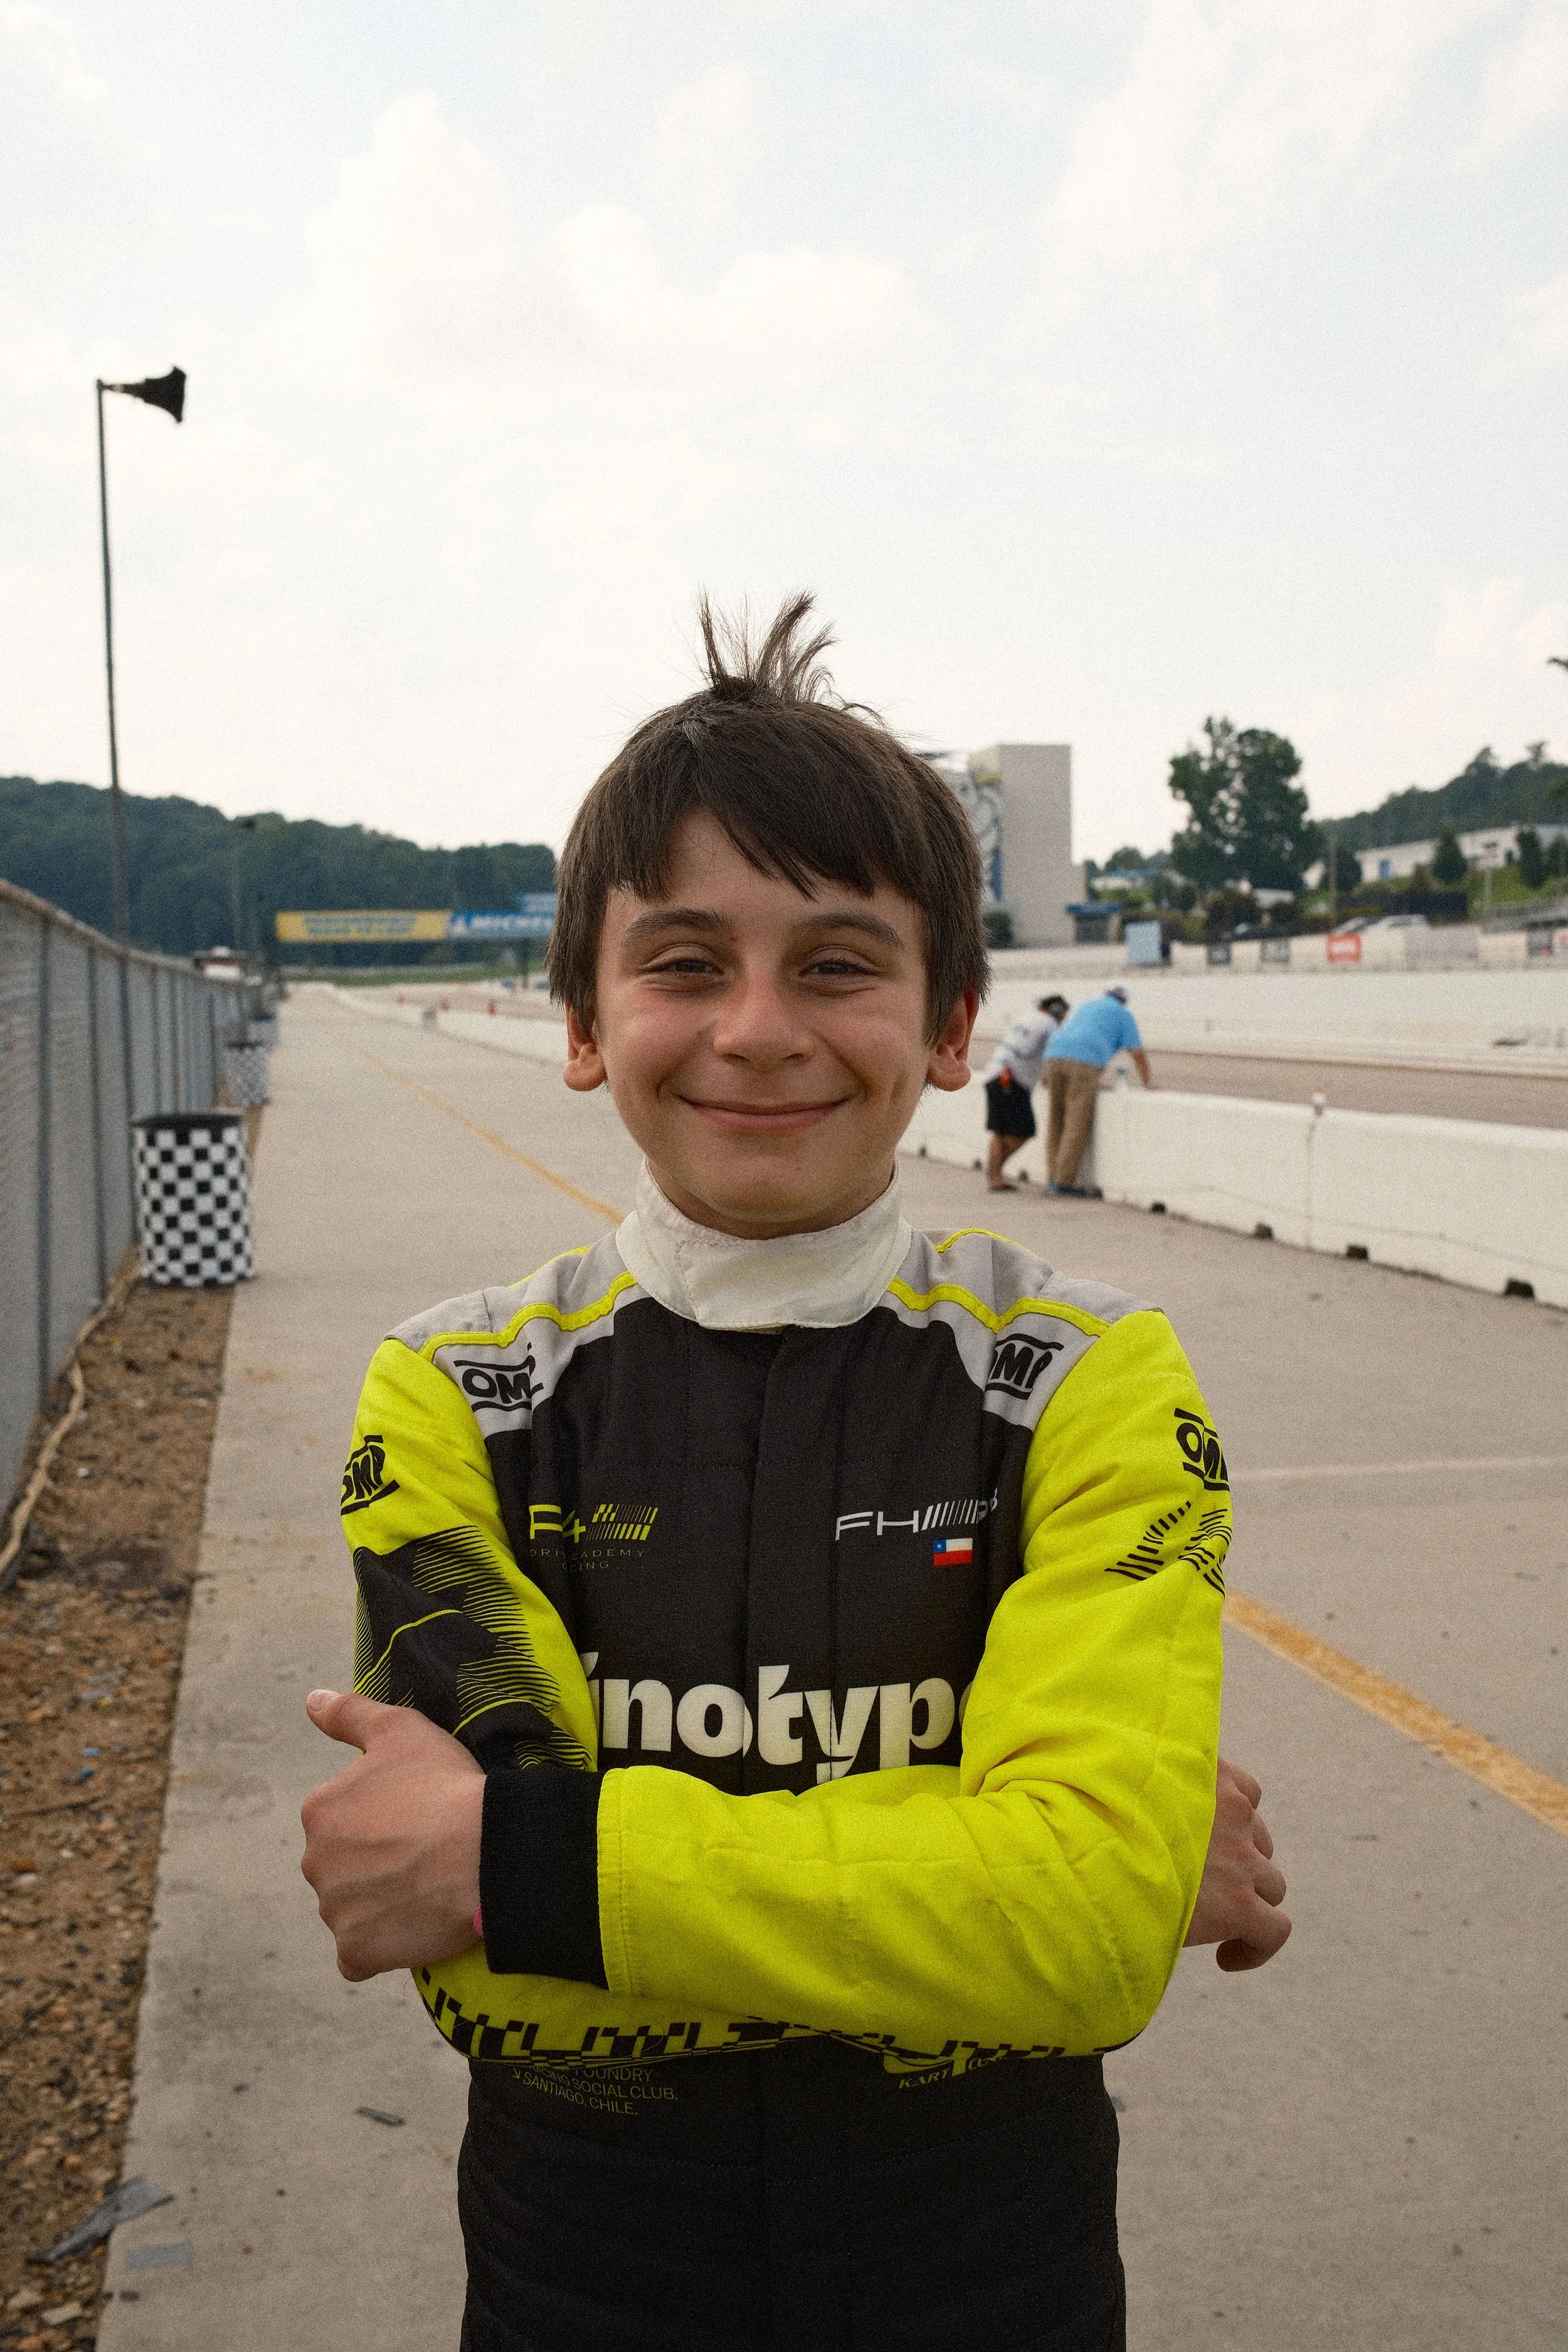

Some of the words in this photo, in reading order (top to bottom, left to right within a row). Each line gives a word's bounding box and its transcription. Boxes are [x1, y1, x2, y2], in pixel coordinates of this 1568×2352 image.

[462, 1355, 537, 1405] OM
[569, 1560, 609, 1572] CING
[572, 1549, 644, 1560] CADEMY
[529, 2065, 571, 2086] ACING
[571, 2077, 628, 2099] SOCIAL
[630, 2085, 678, 2100] CLUB.
[899, 2067, 951, 2089] KART
[522, 2071, 587, 2106] SANTIAGO,
[589, 2097, 638, 2115] CHILE.
